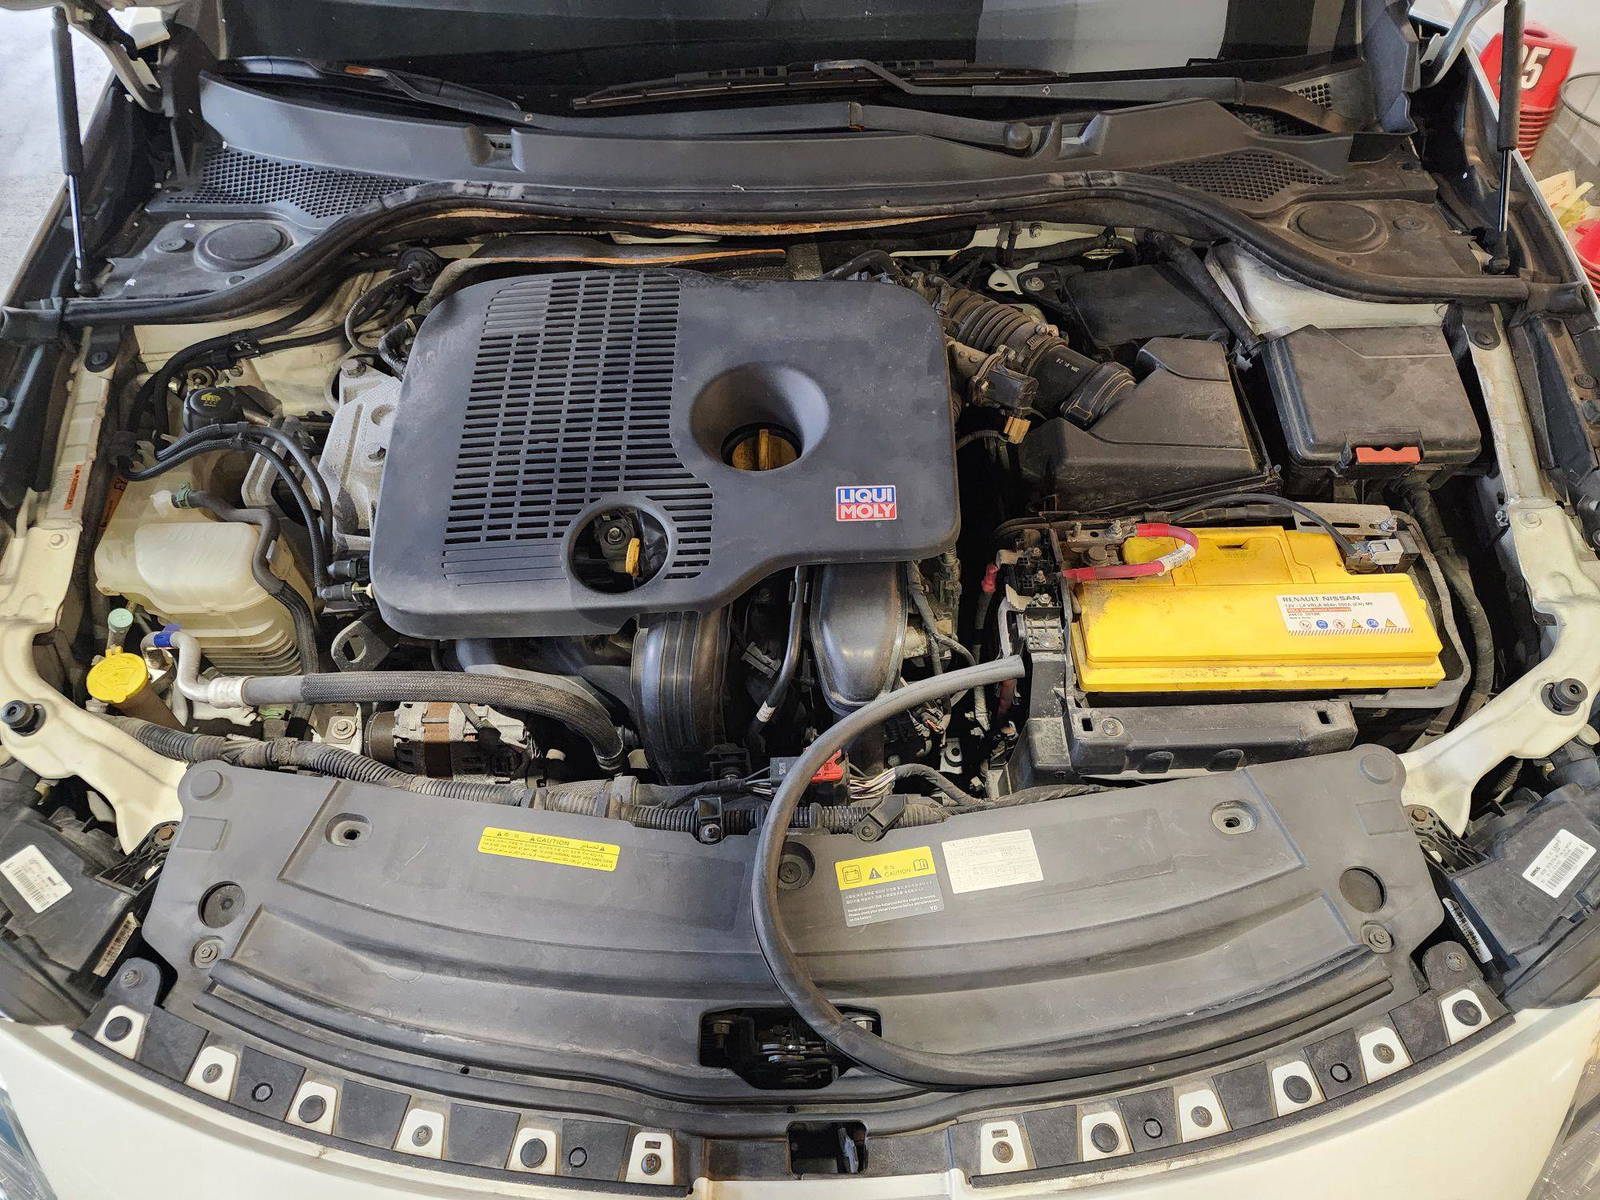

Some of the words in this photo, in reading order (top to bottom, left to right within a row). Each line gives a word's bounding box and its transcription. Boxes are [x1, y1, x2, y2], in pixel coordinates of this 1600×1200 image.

[840, 488, 893, 503] LIQUI
[840, 503, 894, 519] MOLY
[536, 837, 570, 846] CAUTION
[884, 868, 911, 877] CAUTION
